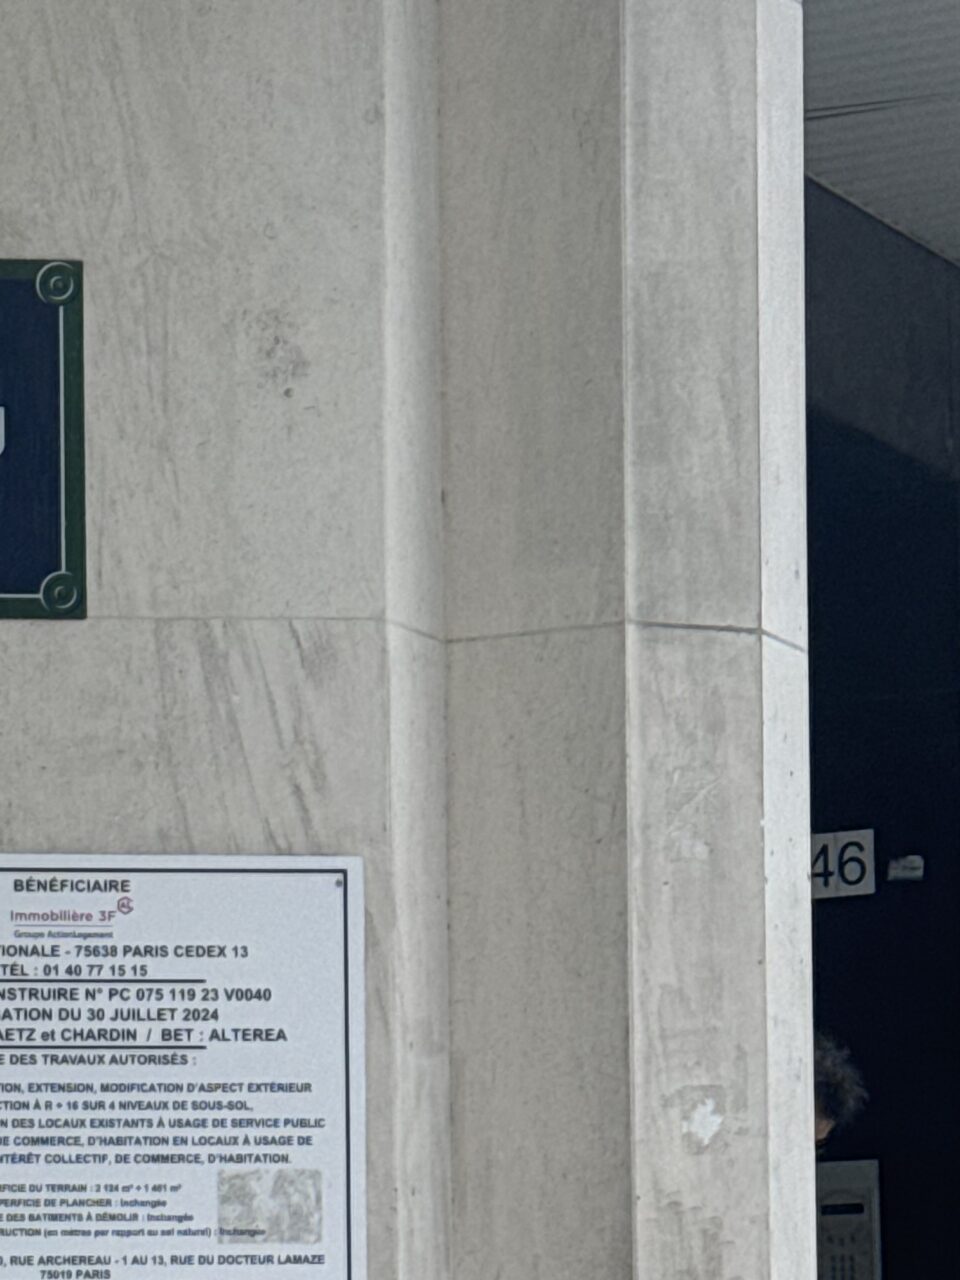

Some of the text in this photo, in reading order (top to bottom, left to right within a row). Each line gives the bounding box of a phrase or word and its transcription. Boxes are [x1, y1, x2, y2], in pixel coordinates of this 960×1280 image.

[812, 840, 867, 888] 46
[13, 878, 130, 893] BÉNÉFICIAIRE
[10, 910, 116, 922] Immobilière 3F
[74, 945, 118, 958] 75638
[122, 945, 168, 958] PARIS
[173, 945, 226, 958] CEDEX
[232, 945, 248, 958] 13
[0, 963, 147, 977] TÉL 01 40 77 15 15
[84, 988, 102, 1001] N°
[108, 988, 130, 1001] PC
[135, 988, 164, 1001] 075
[169, 988, 196, 1001] 119
[200, 988, 219, 1001] 23
[223, 988, 271, 1001] V0040
[57, 1008, 81, 1022] DU
[86, 1008, 105, 1022] 30
[110, 1008, 176, 1022] JUILLET
[182, 1008, 219, 1022] 2024
[40, 1030, 56, 1042] et
[60, 1028, 137, 1042] CHARDIN
[160, 1028, 192, 1042] BET
[208, 1028, 286, 1042] ALTEREA
[9, 1054, 37, 1065] DES
[42, 1054, 105, 1065] TRAVAUX
[108, 1053, 188, 1065] AUTORISÉS
[99, 1083, 184, 1093] MODIFICATION
[186, 1083, 243, 1093] D'ASPECT
[246, 1082, 312, 1093] EXTÉRIEUR
[44, 1100, 53, 1111] R
[66, 1100, 78, 1111] 16
[81, 1100, 106, 1111] SUR
[108, 1100, 115, 1111] 4
[118, 1100, 169, 1111] NIVEAUX
[171, 1100, 188, 1111] DE
[10, 1118, 35, 1128] DES
[37, 1118, 86, 1128] LOCAUX
[88, 1118, 154, 1128] EXISTANTS
[168, 1118, 208, 1128] USAGE
[211, 1118, 227, 1128] DE
[230, 1118, 281, 1128] SERVICE
[282, 1118, 325, 1128] PUBLIC
[86, 1136, 169, 1146] D'HABITATION
[171, 1136, 188, 1146] EN
[191, 1136, 239, 1146] LOCAUX
[253, 1136, 294, 1146] USAGE
[296, 1136, 313, 1146] DE
[114, 1154, 131, 1164] DE
[40, 1270, 111, 1279] 75019 PARIS
